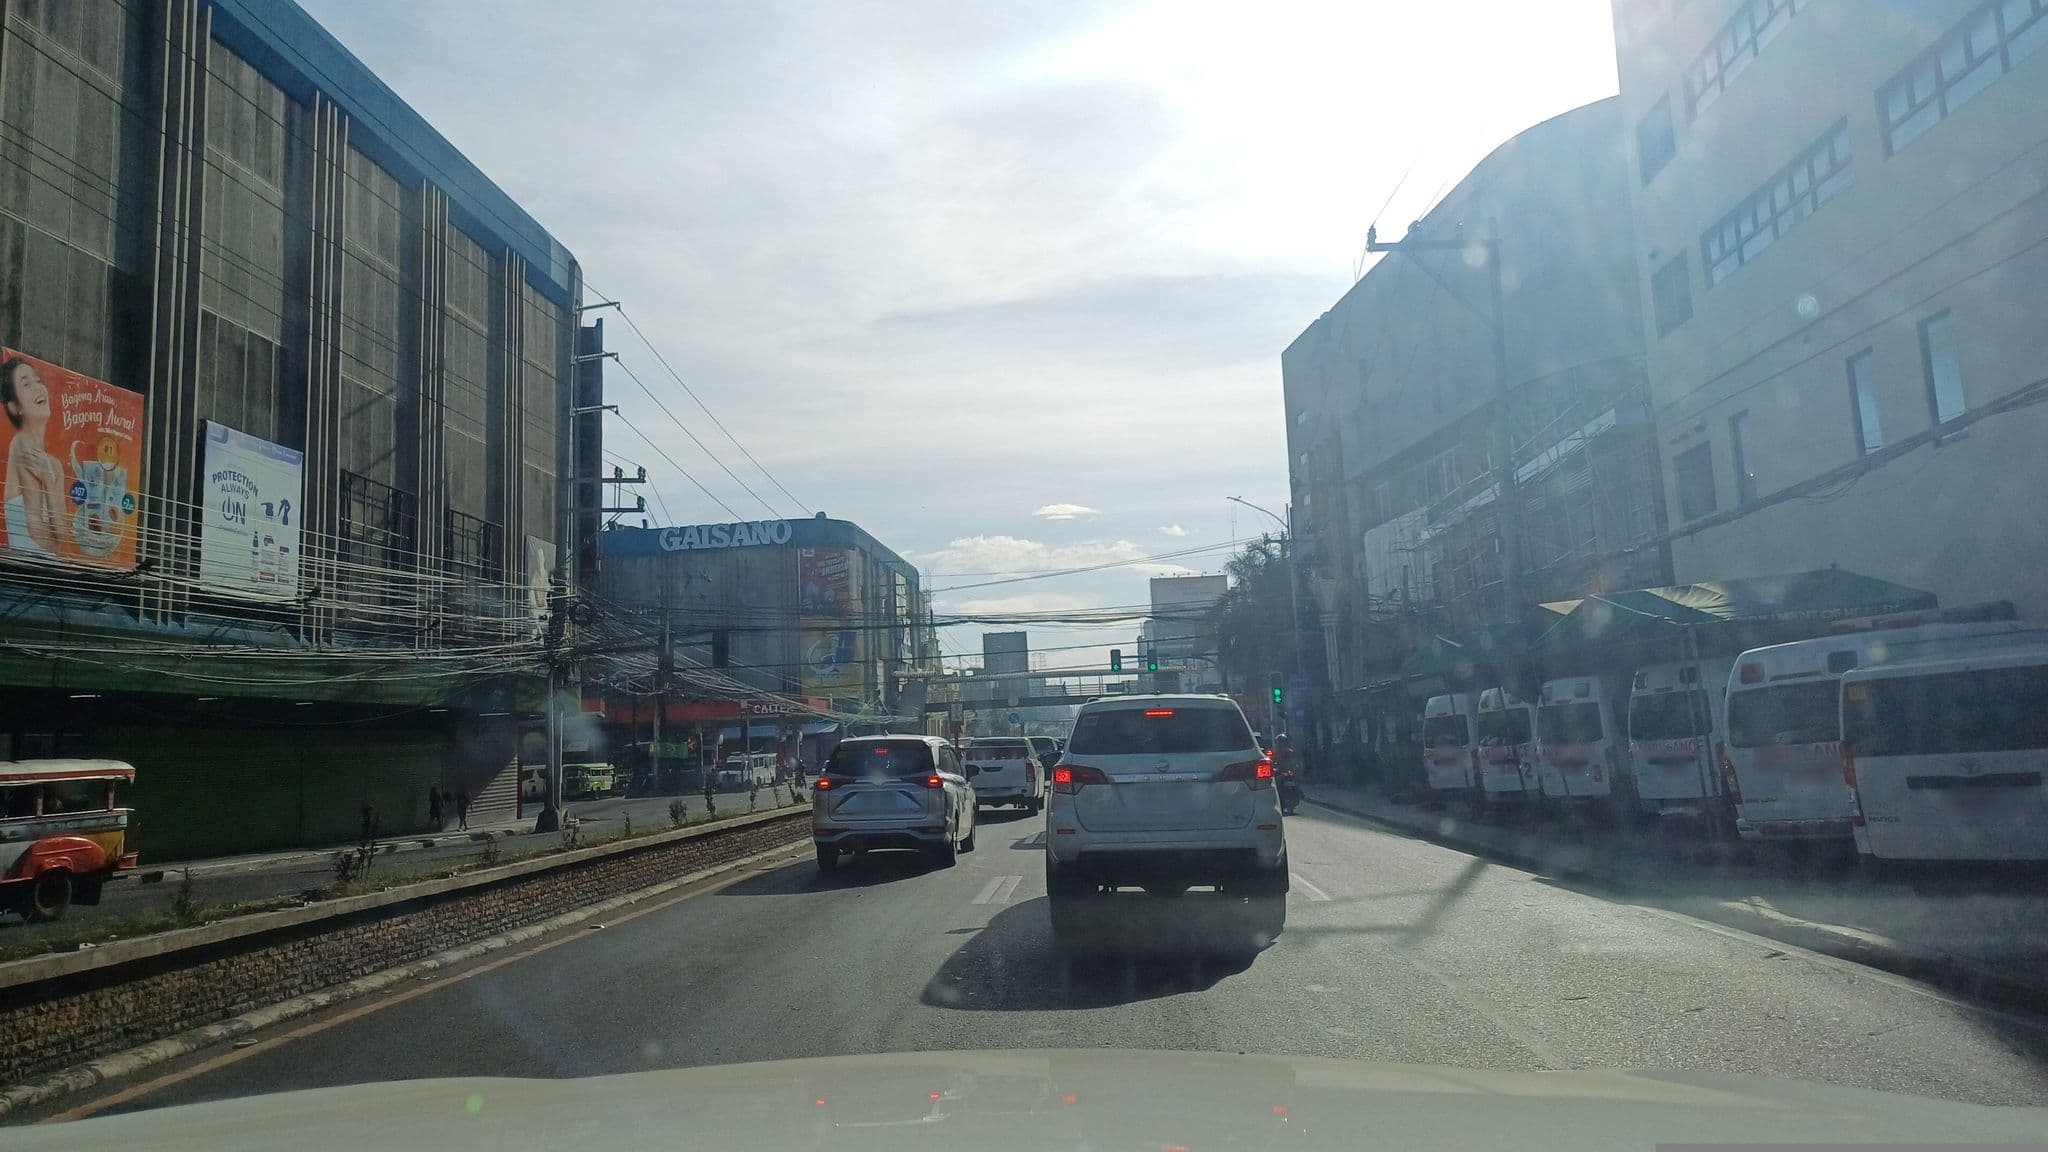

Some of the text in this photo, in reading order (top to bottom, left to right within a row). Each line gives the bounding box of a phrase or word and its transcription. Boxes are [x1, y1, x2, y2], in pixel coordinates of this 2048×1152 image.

[61, 392, 93, 409] Bagong
[62, 407, 136, 433] Bagong Aura!
[212, 470, 259, 497] PROTECTION
[221, 482, 250, 500] ALWAYS
[222, 496, 246, 525] ON
[659, 519, 793, 551] GAISANO
